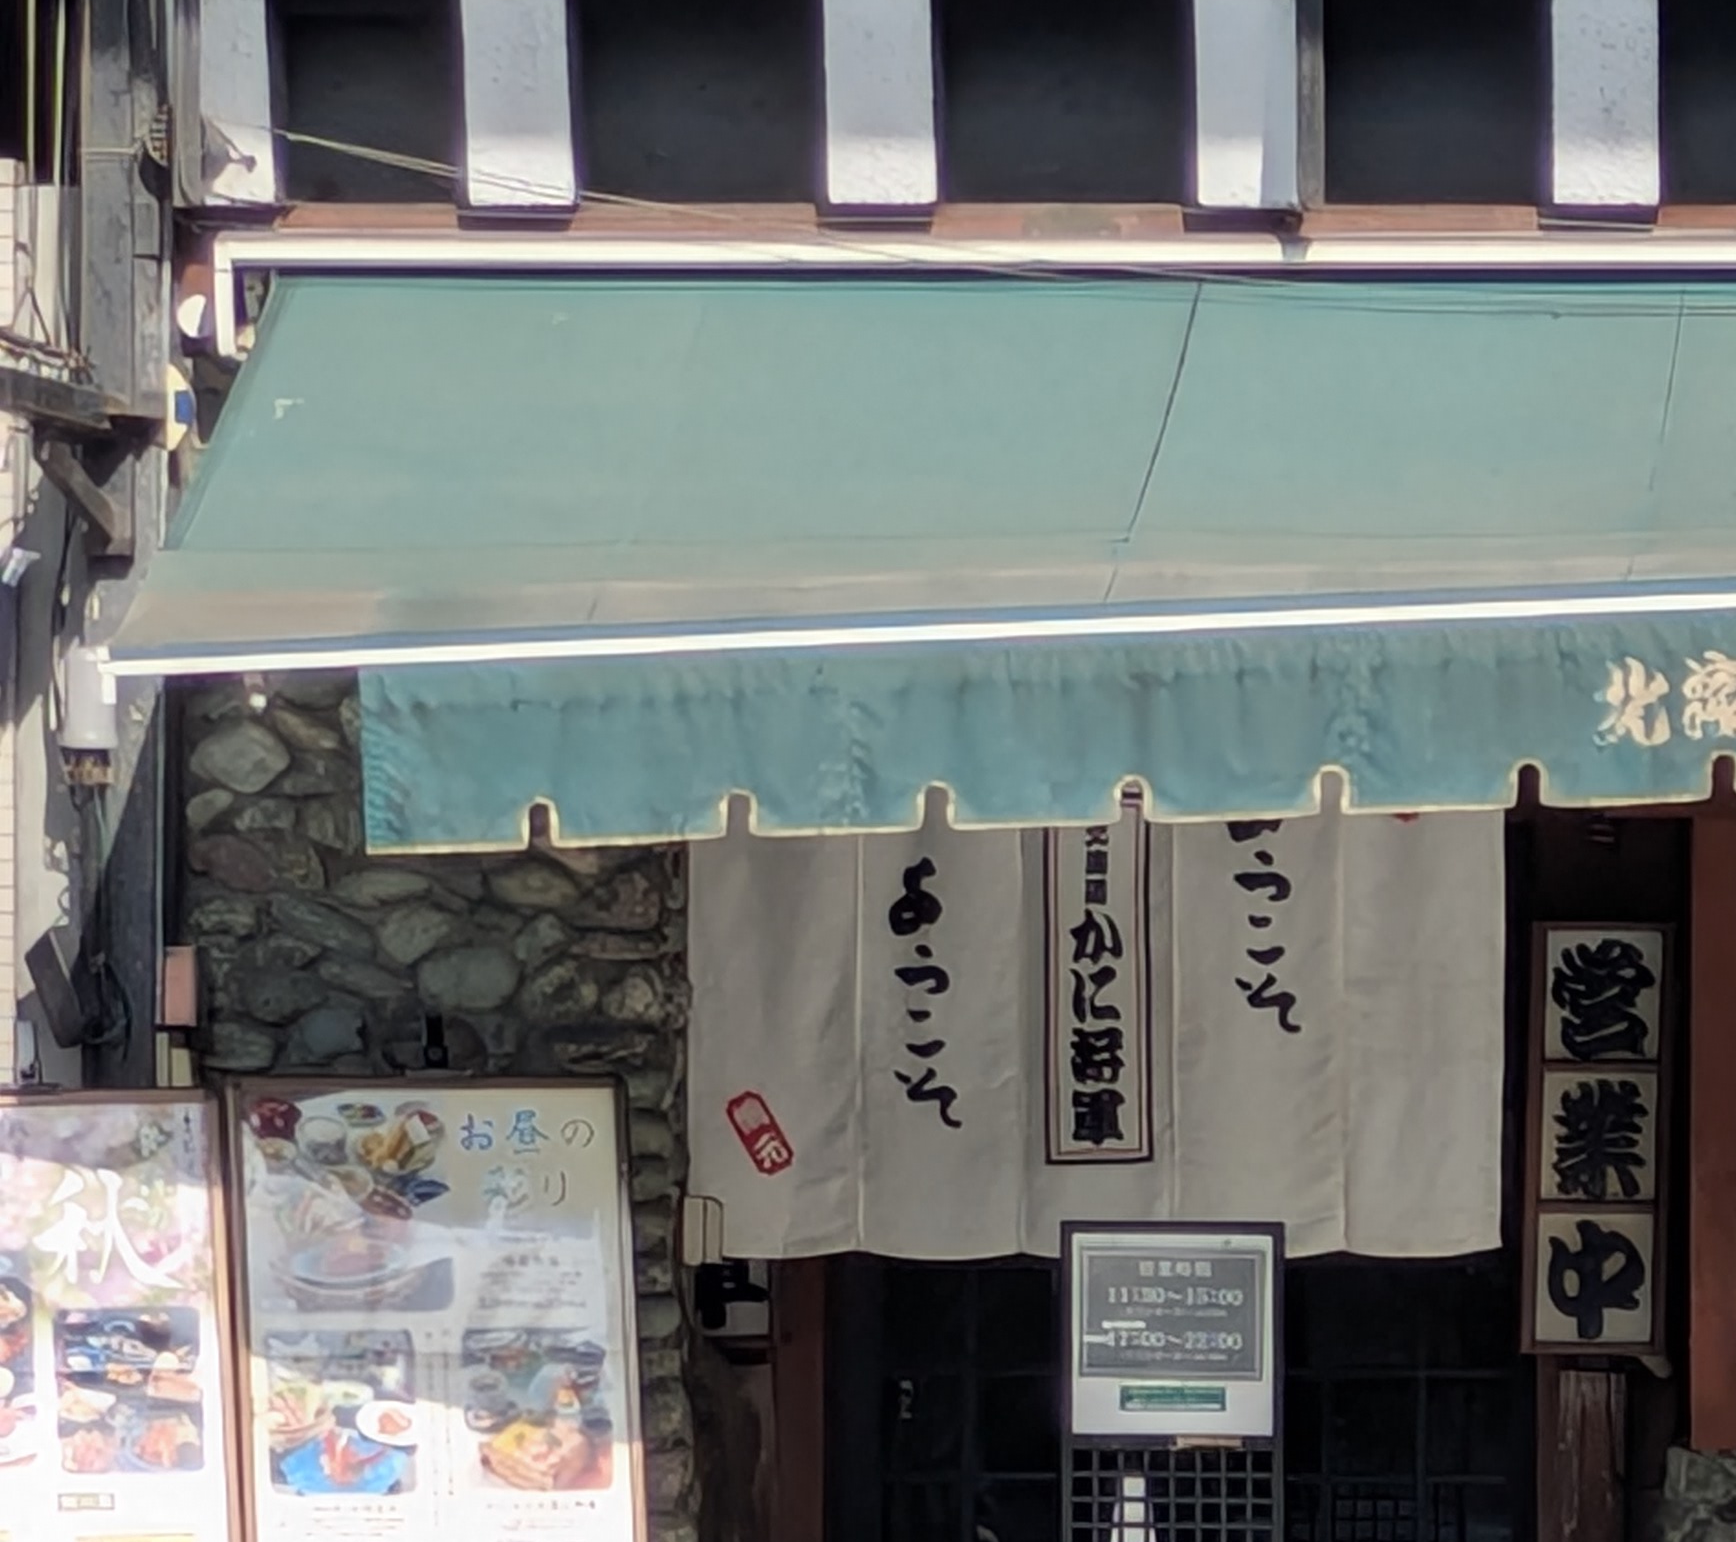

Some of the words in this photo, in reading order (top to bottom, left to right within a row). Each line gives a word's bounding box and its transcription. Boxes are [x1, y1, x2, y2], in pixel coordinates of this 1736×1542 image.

[889, 856, 963, 1129] ようこそ
[32, 1167, 192, 1291] 秋
[460, 1110, 594, 1154] お昼の
[1548, 938, 1656, 1340] 営業中
